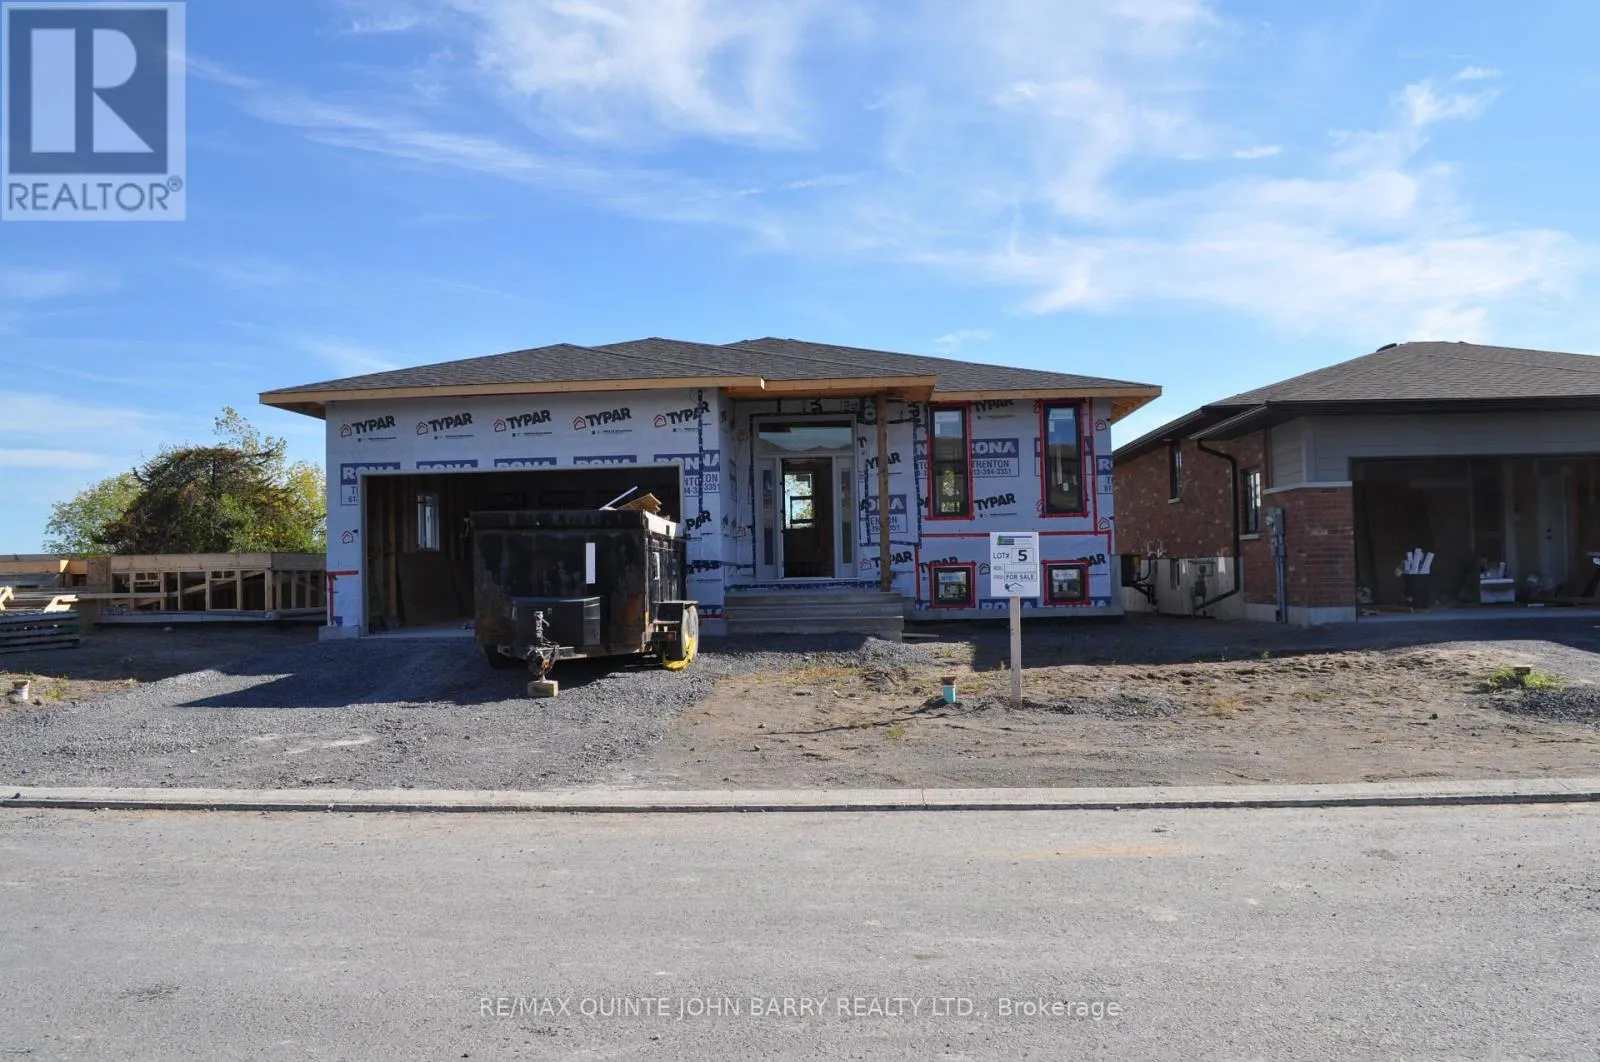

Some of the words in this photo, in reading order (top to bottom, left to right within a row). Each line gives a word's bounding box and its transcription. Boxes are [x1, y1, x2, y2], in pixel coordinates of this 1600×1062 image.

[428, 412, 473, 432] TYPAR
[506, 409, 552, 429] TYPAR
[585, 407, 632, 427] TYPAR
[666, 400, 711, 424] TYPAR
[352, 415, 396, 435] TYPAR
[974, 493, 1016, 511] TYPAR
[992, 552, 1010, 560] LOT#
[1018, 549, 1028, 562] 5
